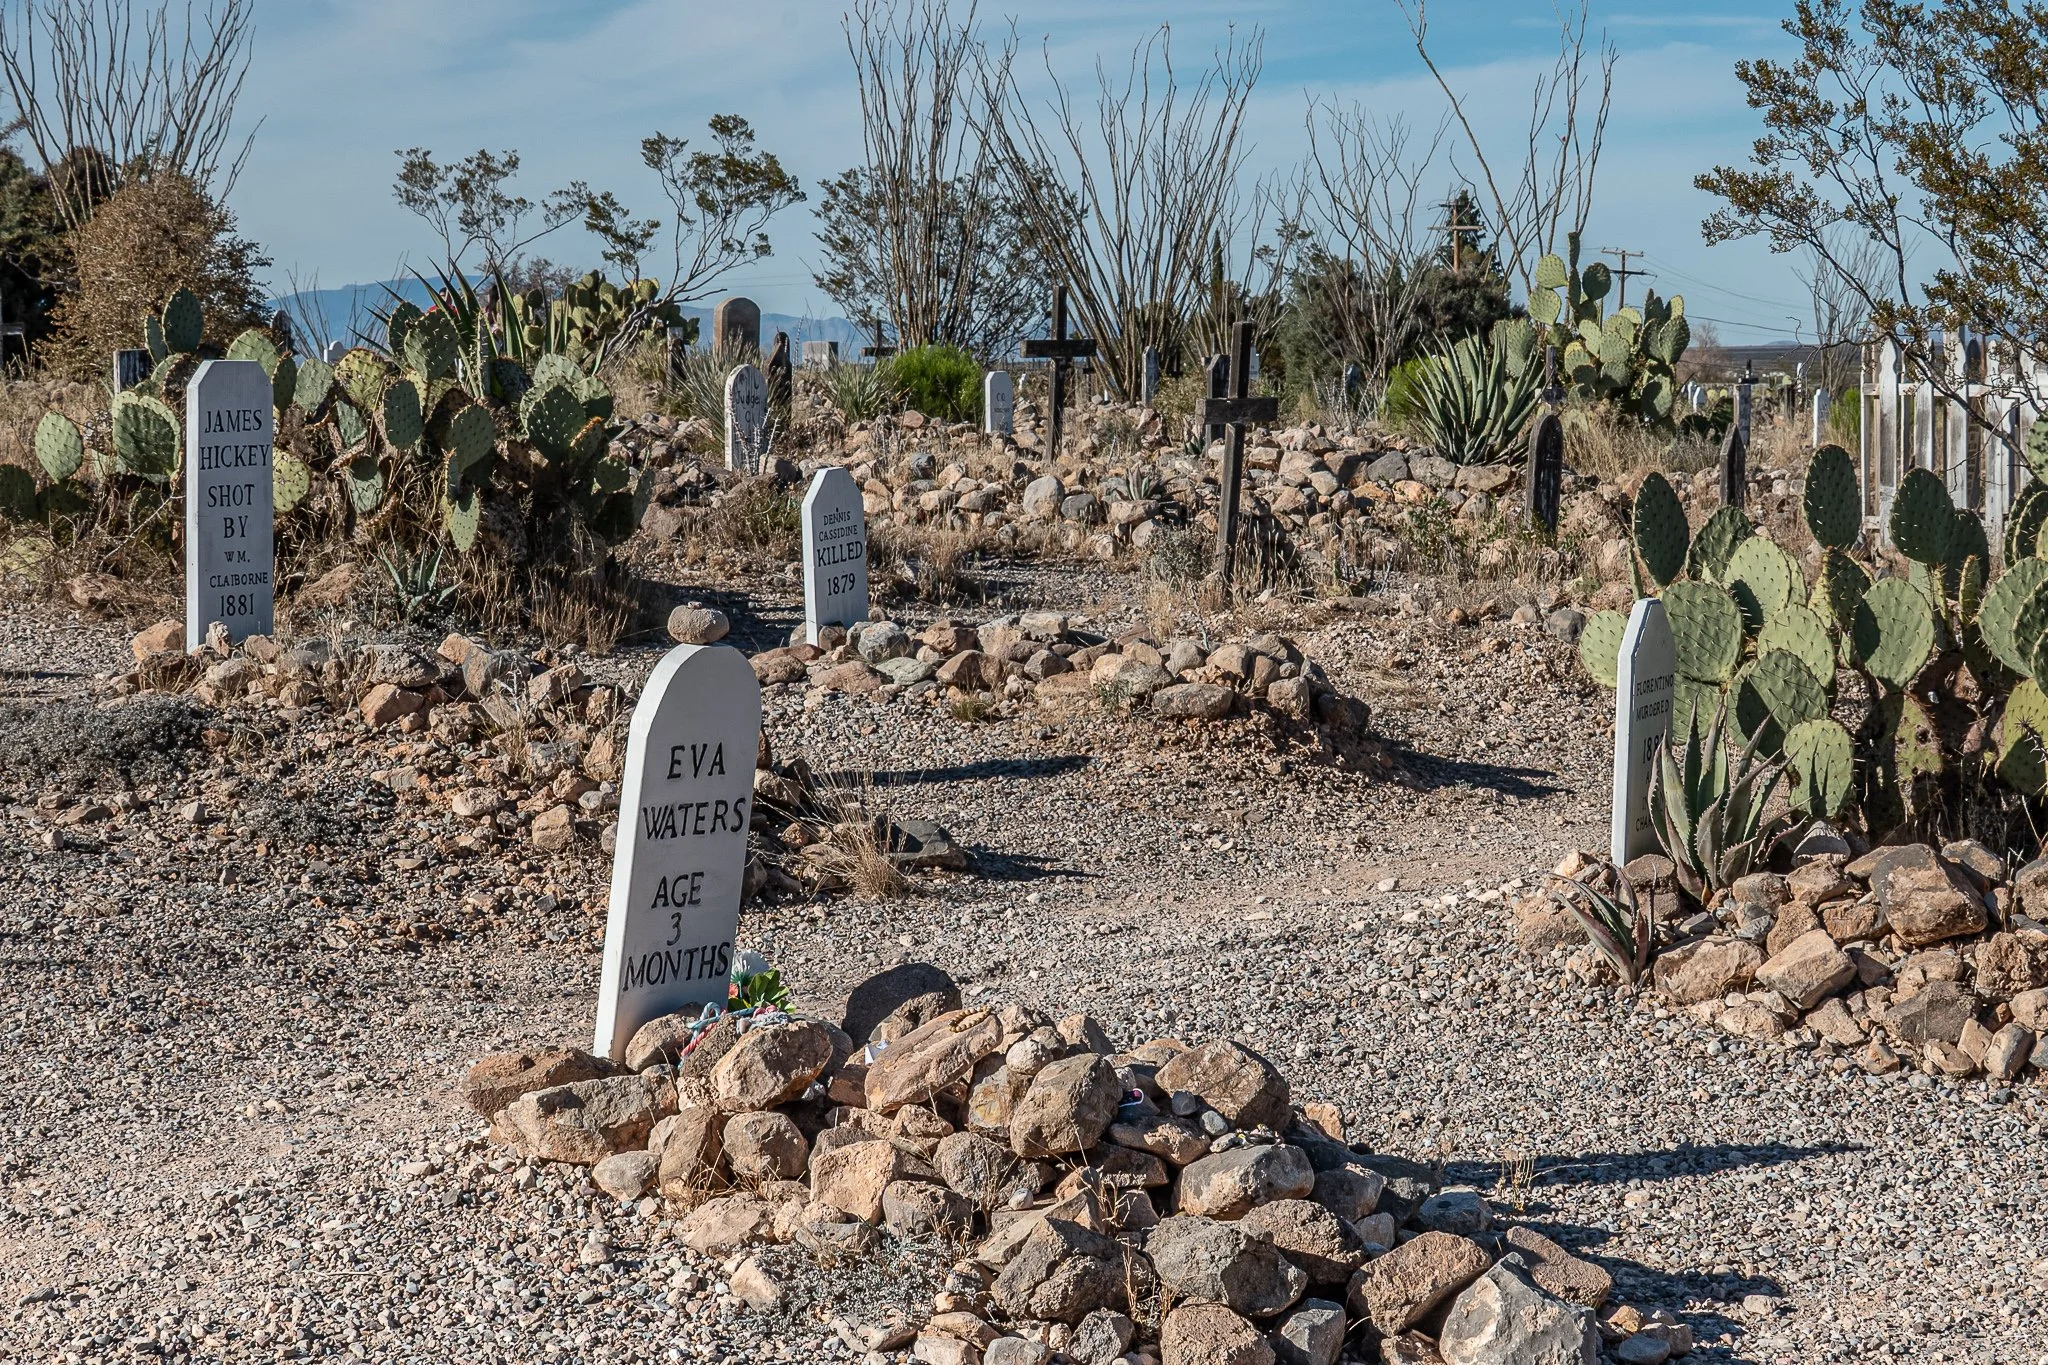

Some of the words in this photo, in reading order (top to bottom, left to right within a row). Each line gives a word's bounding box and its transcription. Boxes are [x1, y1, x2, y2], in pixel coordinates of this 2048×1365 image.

[204, 409, 263, 434] JAMES
[199, 443, 270, 471] HICKEY
[207, 483, 256, 508] SHOT
[223, 515, 249, 539] BY
[823, 510, 851, 526] DENNIS
[818, 524, 858, 542] CASSIDINE
[224, 550, 251, 564] WM.
[816, 541, 864, 568] KILLED
[209, 572, 269, 589] CLAIBORNE
[827, 572, 856, 597] 1879
[219, 592, 255, 617] 1881
[1636, 674, 1674, 697] FLORENTINO
[1635, 699, 1670, 722] MURDERED
[666, 742, 726, 780] EVA
[642, 796, 745, 840] WATERS
[650, 871, 705, 909] AGE
[666, 911, 683, 947] 3
[624, 940, 731, 993] MONTHS
